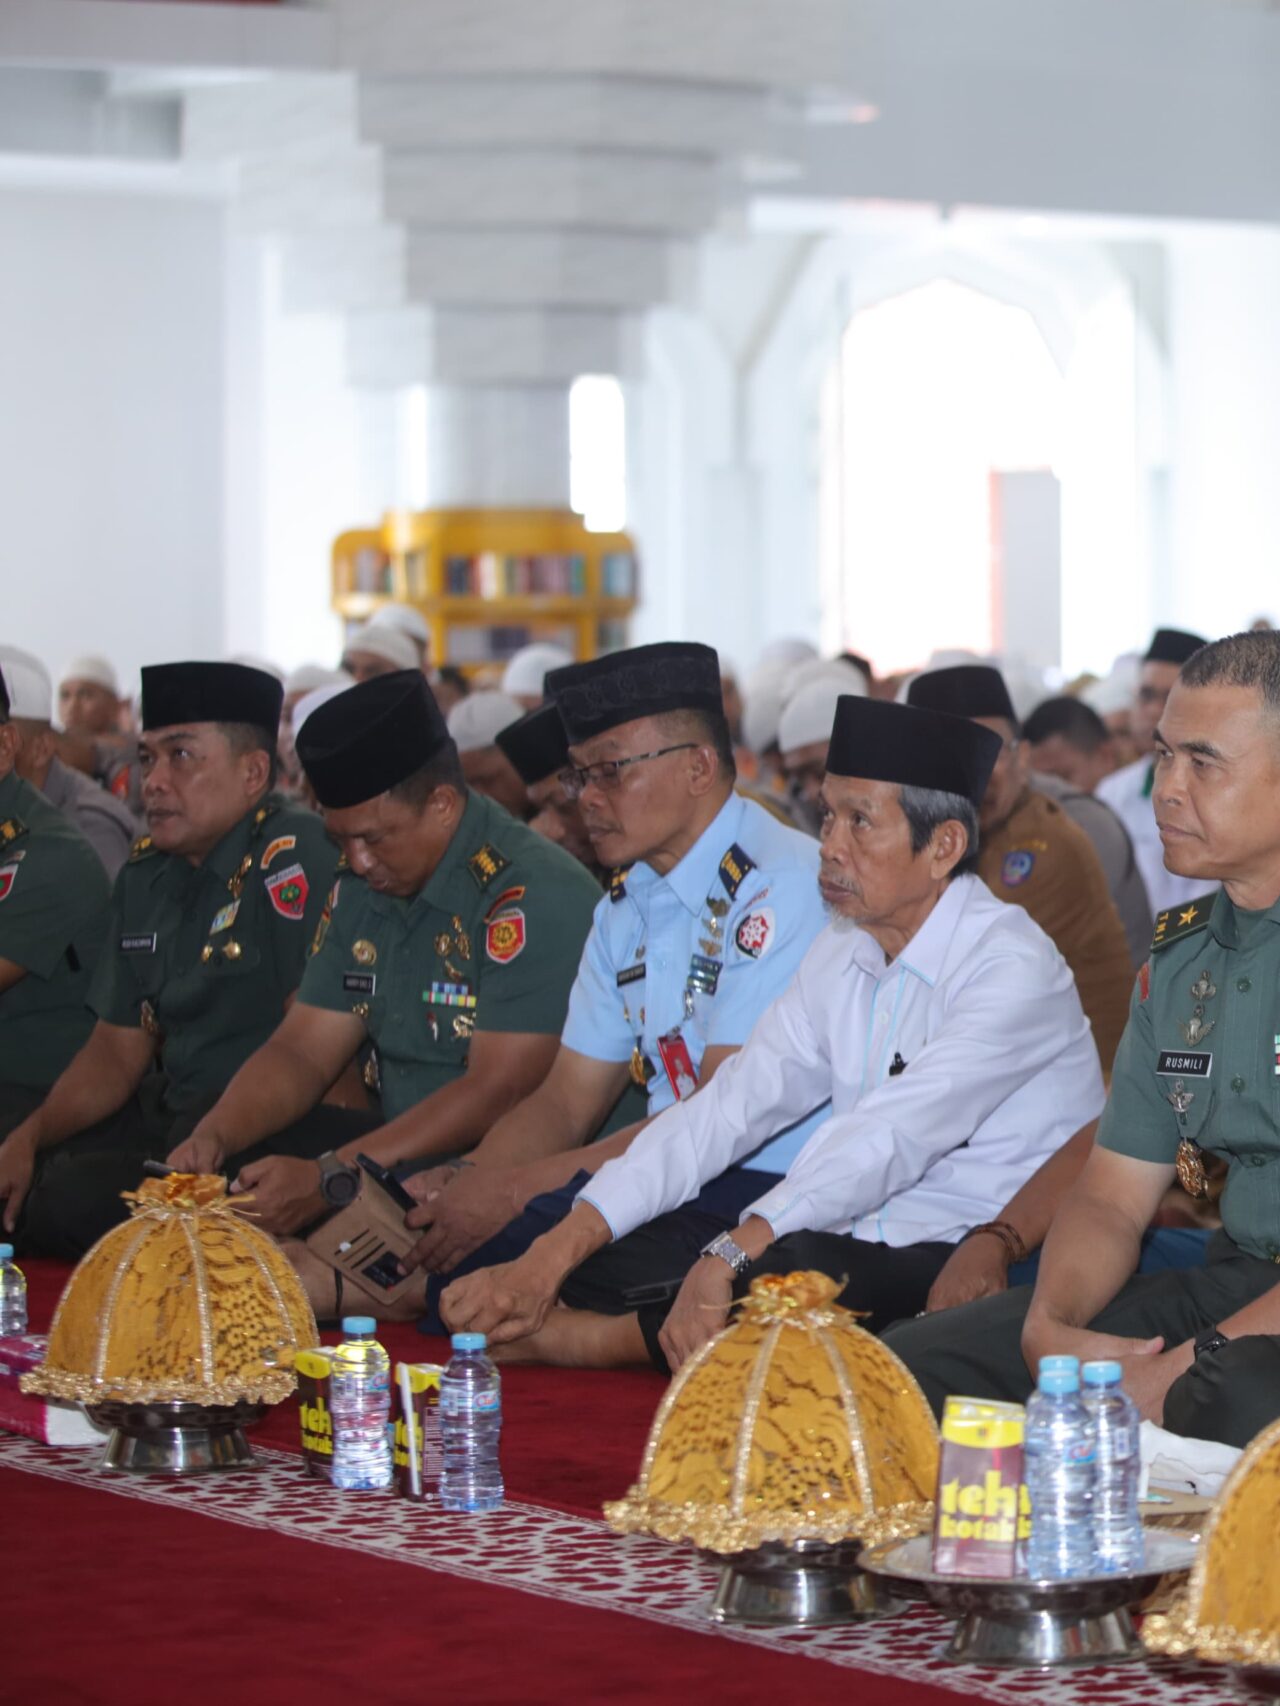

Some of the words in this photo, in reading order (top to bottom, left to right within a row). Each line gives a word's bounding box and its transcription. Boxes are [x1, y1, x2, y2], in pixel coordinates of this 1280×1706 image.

[1154, 911, 1169, 942] TNI
[1165, 1056, 1203, 1070] RUSMILI
[299, 1396, 333, 1436] teh
[941, 1469, 1018, 1518] teh
[939, 1514, 1015, 1543] kotak
